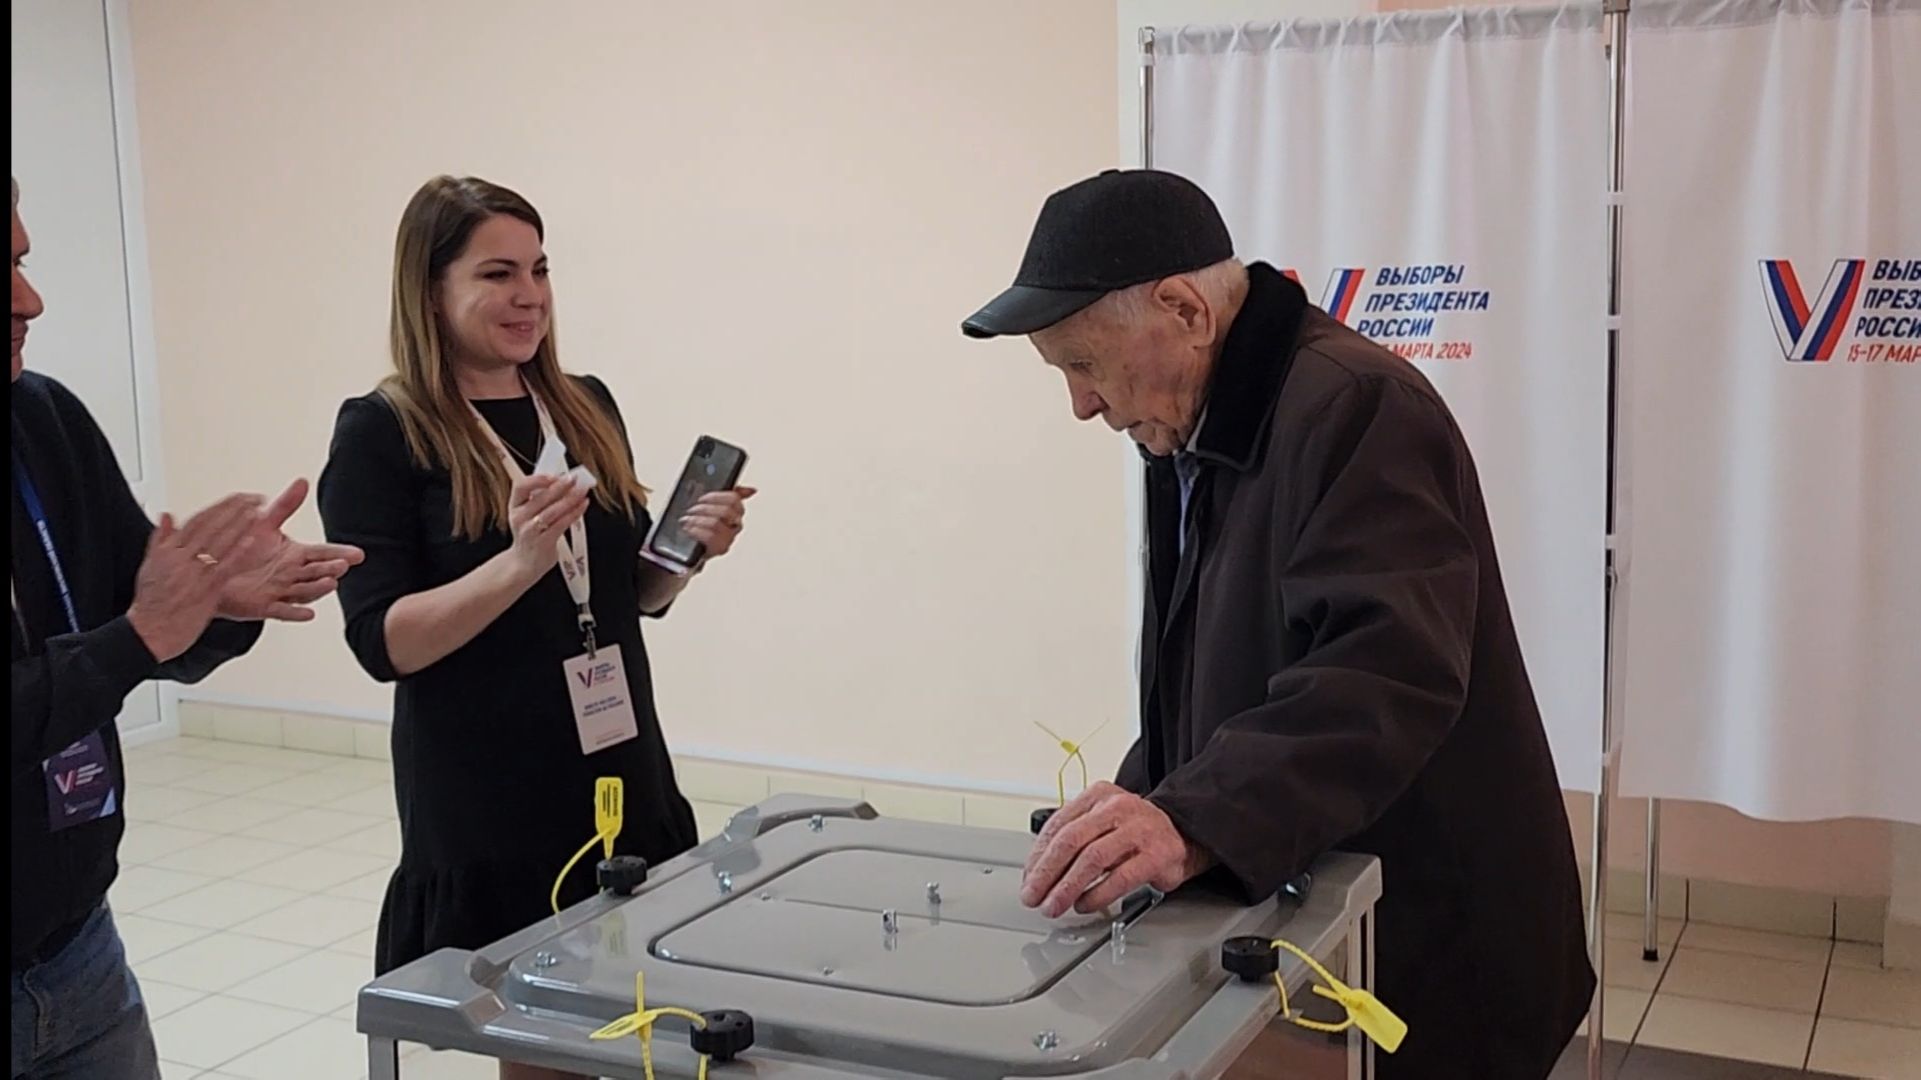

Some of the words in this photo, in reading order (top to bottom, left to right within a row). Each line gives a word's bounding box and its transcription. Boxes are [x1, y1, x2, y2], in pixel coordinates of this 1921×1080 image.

[1375, 265, 1465, 286] ВЫБОРЫ
[1872, 259, 1921, 281] ВЫБ
[1364, 291, 1490, 313] ПРЕЗИДЕНТА
[1863, 288, 1921, 310] ПРЕЗ
[1357, 318, 1435, 337] РОССИИ
[1392, 343, 1434, 360] МАРТА
[1435, 342, 1473, 360] 2024
